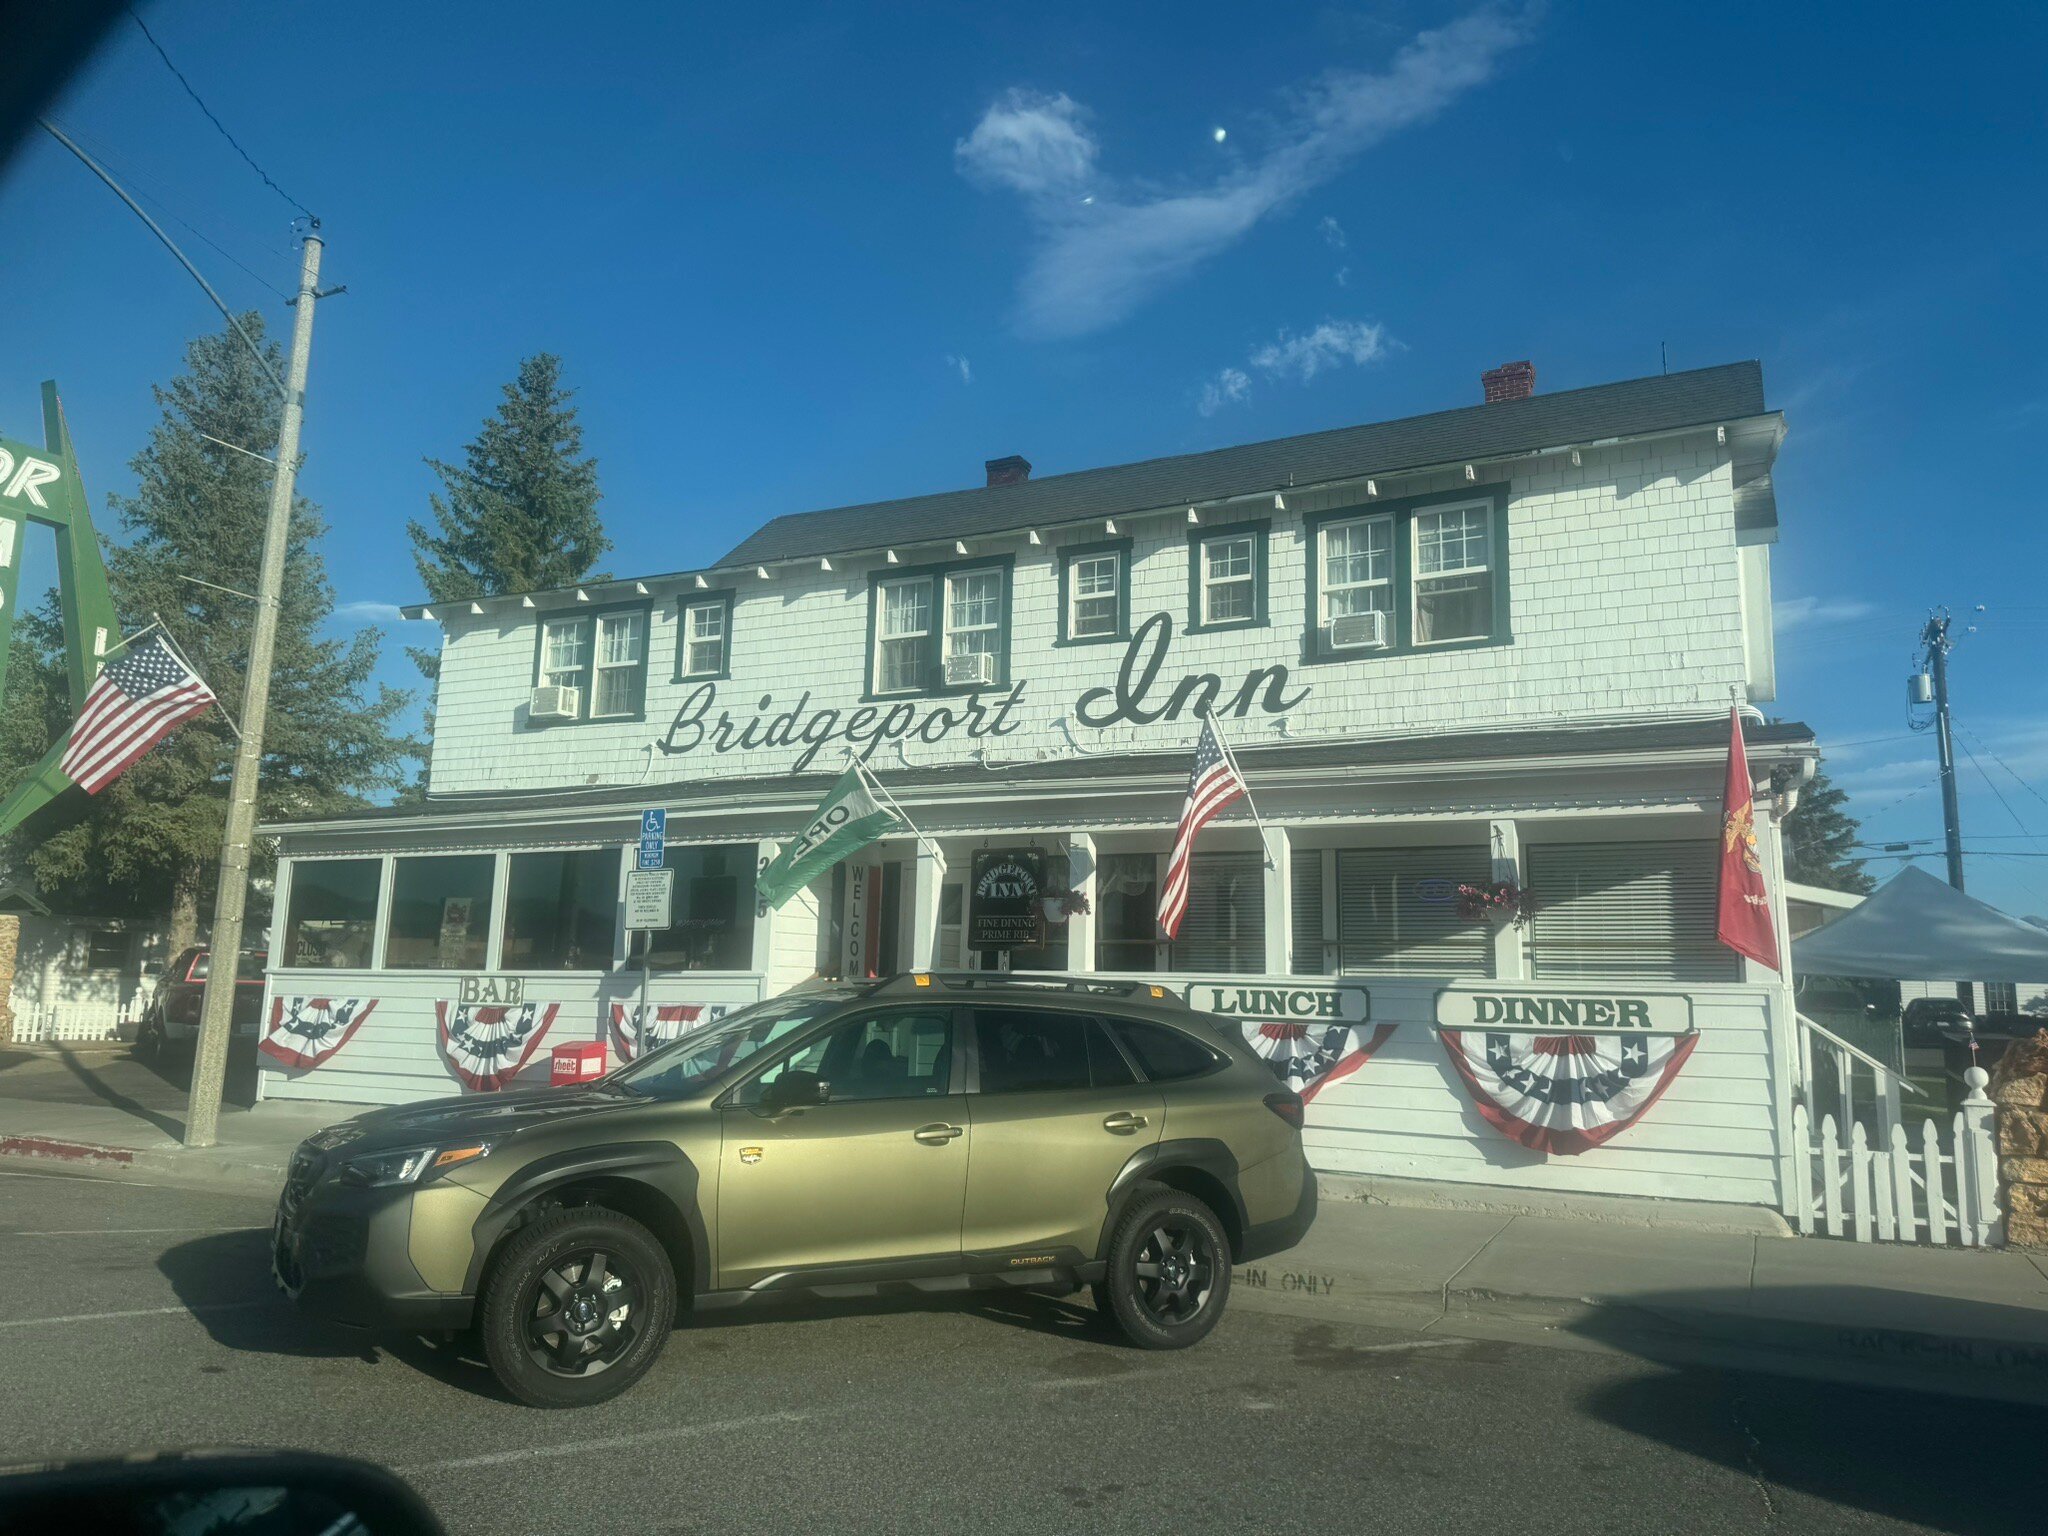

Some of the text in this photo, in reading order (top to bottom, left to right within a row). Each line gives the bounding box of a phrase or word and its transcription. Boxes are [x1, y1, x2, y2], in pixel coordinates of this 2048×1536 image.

[656, 611, 1311, 772] Bridgeport Inn
[642, 831, 663, 840] PARKING
[645, 841, 659, 849] ONLY
[756, 856, 770, 918] 25
[976, 863, 1038, 897] BRIDGEPORT
[989, 881, 1026, 898] INN
[848, 865, 864, 976] WELCOM
[978, 918, 1036, 928] FINE DINING
[982, 930, 1029, 939] PRIME RIB
[461, 977, 521, 1004] BAR
[1211, 988, 1343, 1018] LUNCH
[1472, 996, 1652, 1028] DINNER
[1010, 1255, 1056, 1265] OUTBACK
[1281, 1272, 1334, 1296] ONLY
